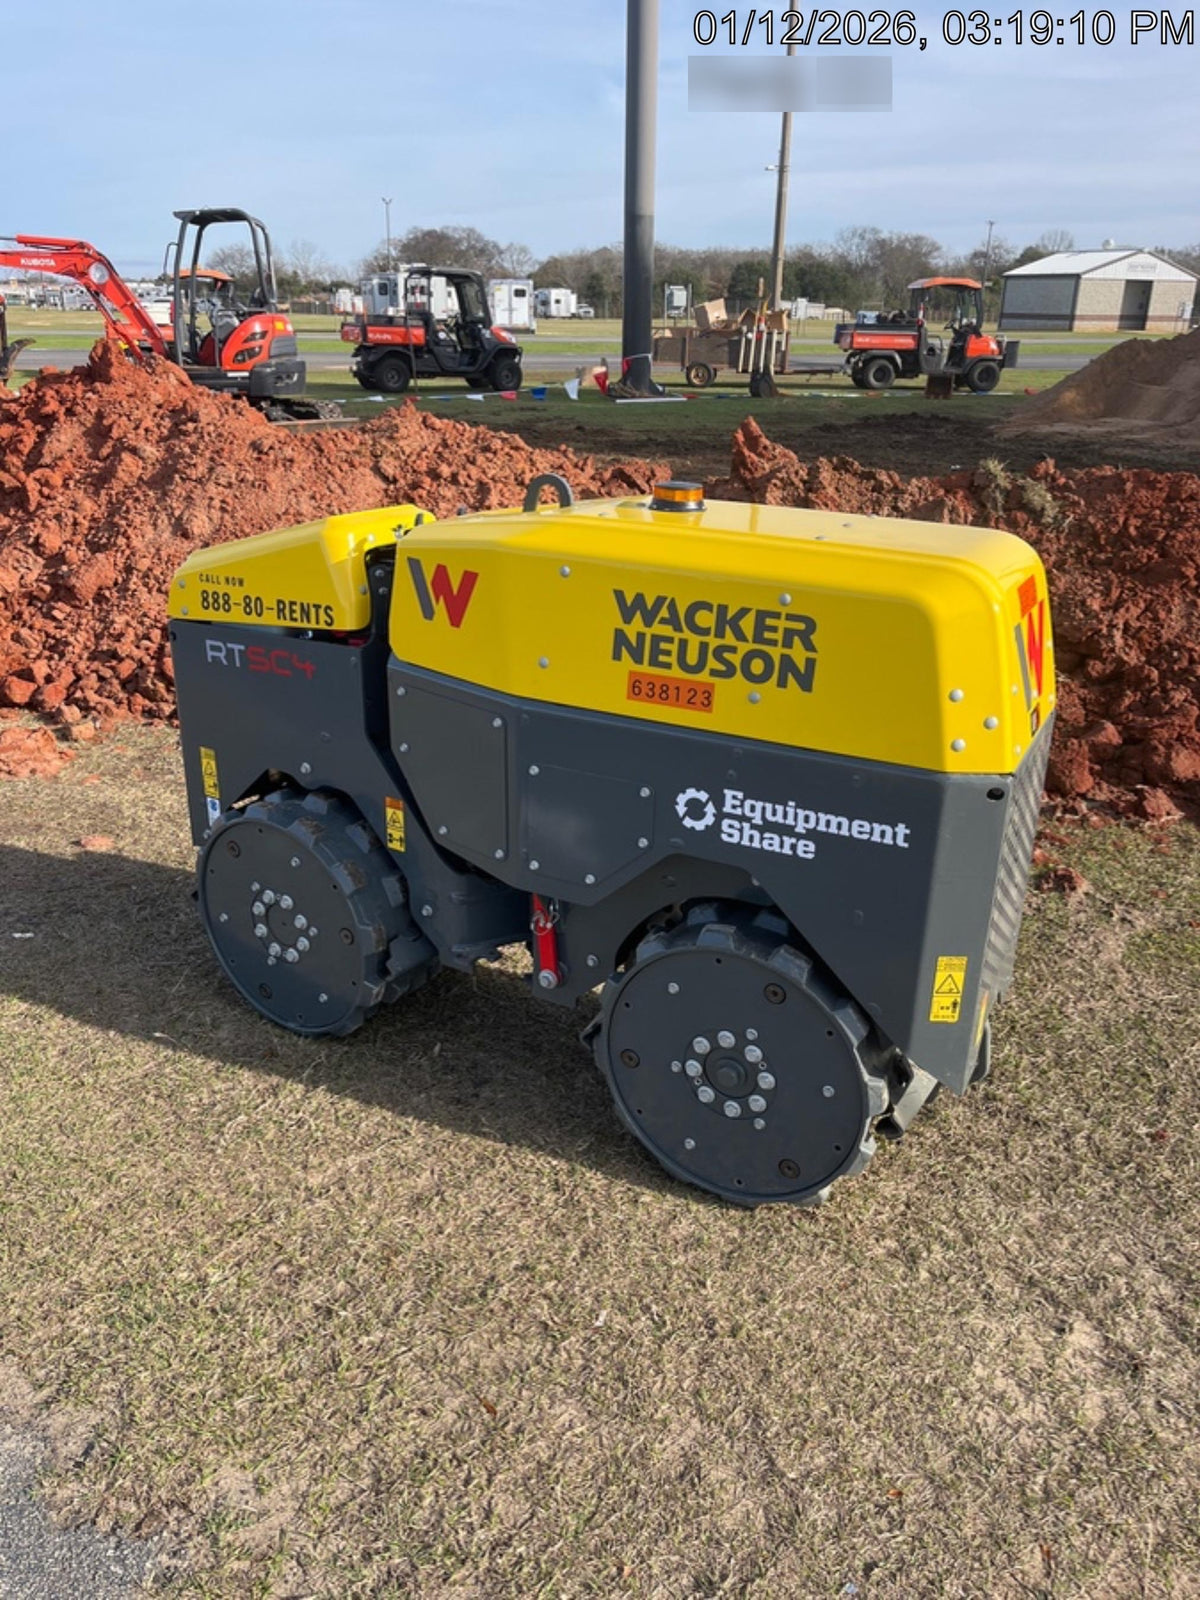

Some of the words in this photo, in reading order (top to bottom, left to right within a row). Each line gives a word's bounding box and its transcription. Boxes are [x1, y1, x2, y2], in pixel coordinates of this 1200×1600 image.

[199, 573, 222, 585] CALL
[224, 576, 245, 588] NOW
[200, 589, 335, 627] 888-80-RENTS
[612, 588, 819, 653] WACKER
[205, 639, 316, 680] RTSC4
[611, 627, 818, 693] NEUSON
[631, 679, 713, 708] 638123
[720, 818, 816, 860] Share
[722, 788, 911, 849] Equipment
